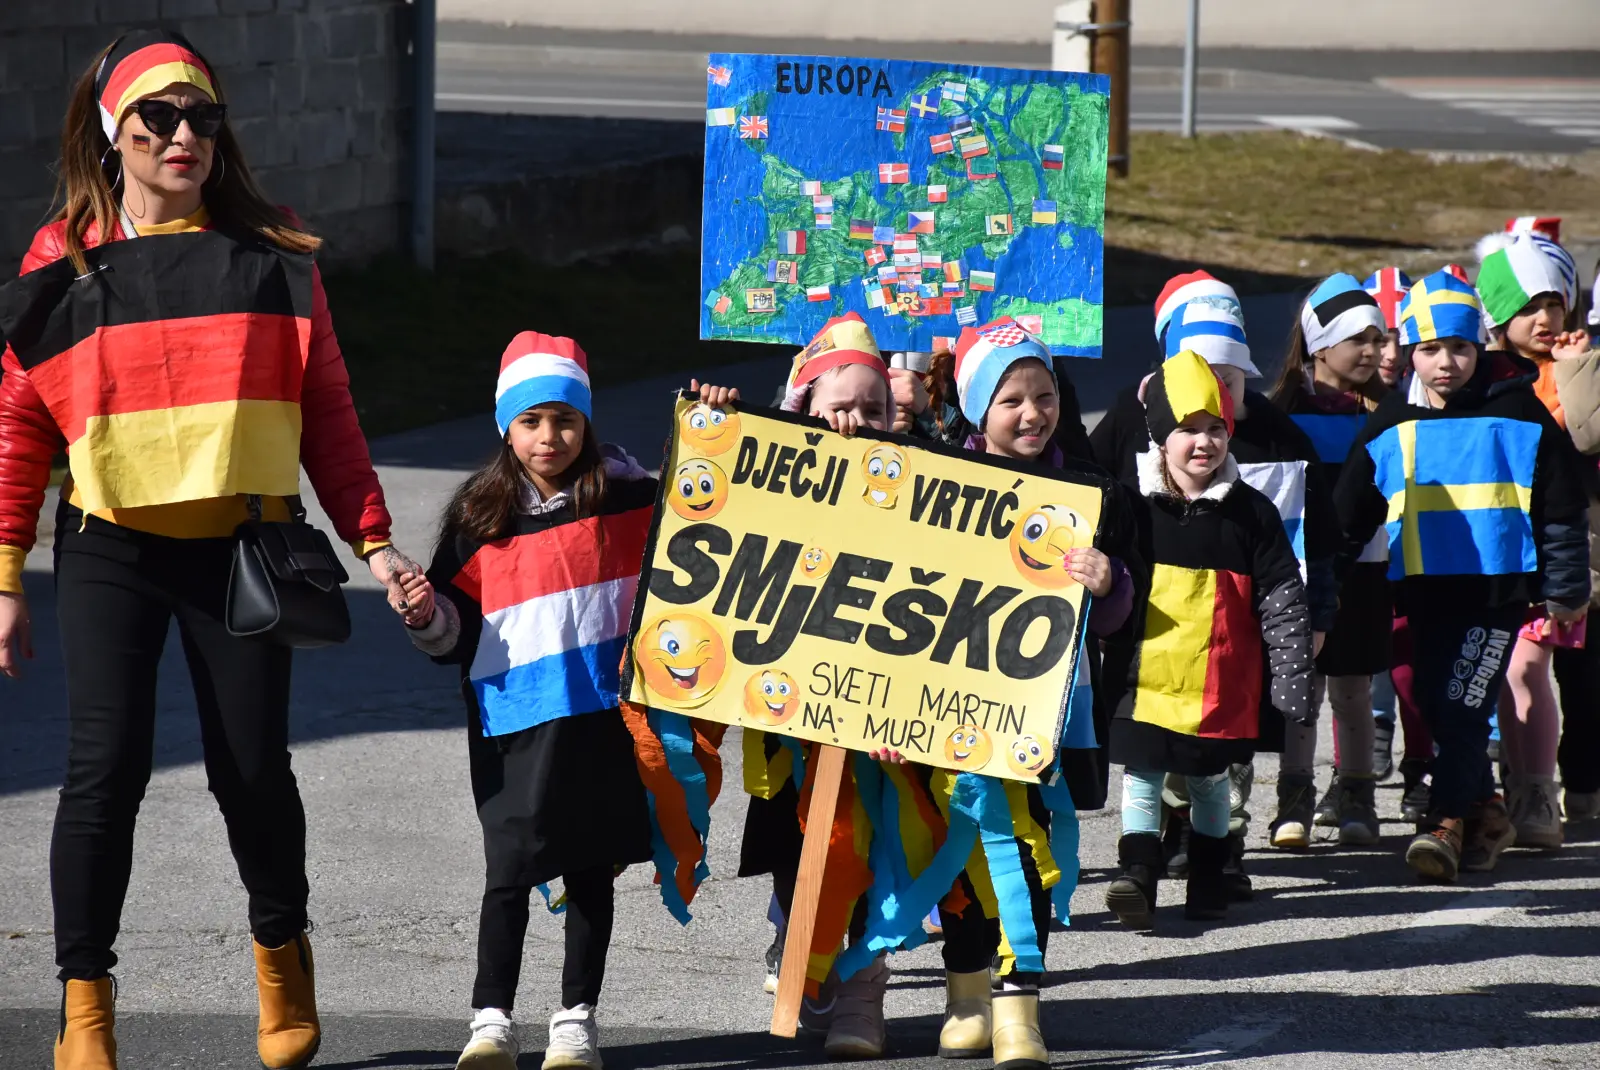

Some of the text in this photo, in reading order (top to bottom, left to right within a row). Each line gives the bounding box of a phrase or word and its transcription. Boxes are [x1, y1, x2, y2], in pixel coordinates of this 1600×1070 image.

[776, 62, 893, 98] EUROPA
[732, 432, 1024, 540] DJEČJI VRTIĆ
[808, 662, 1026, 736] SVETI MARTIN
[1464, 628, 1511, 708] AVENGERS
[802, 706, 935, 754] NA MURI
